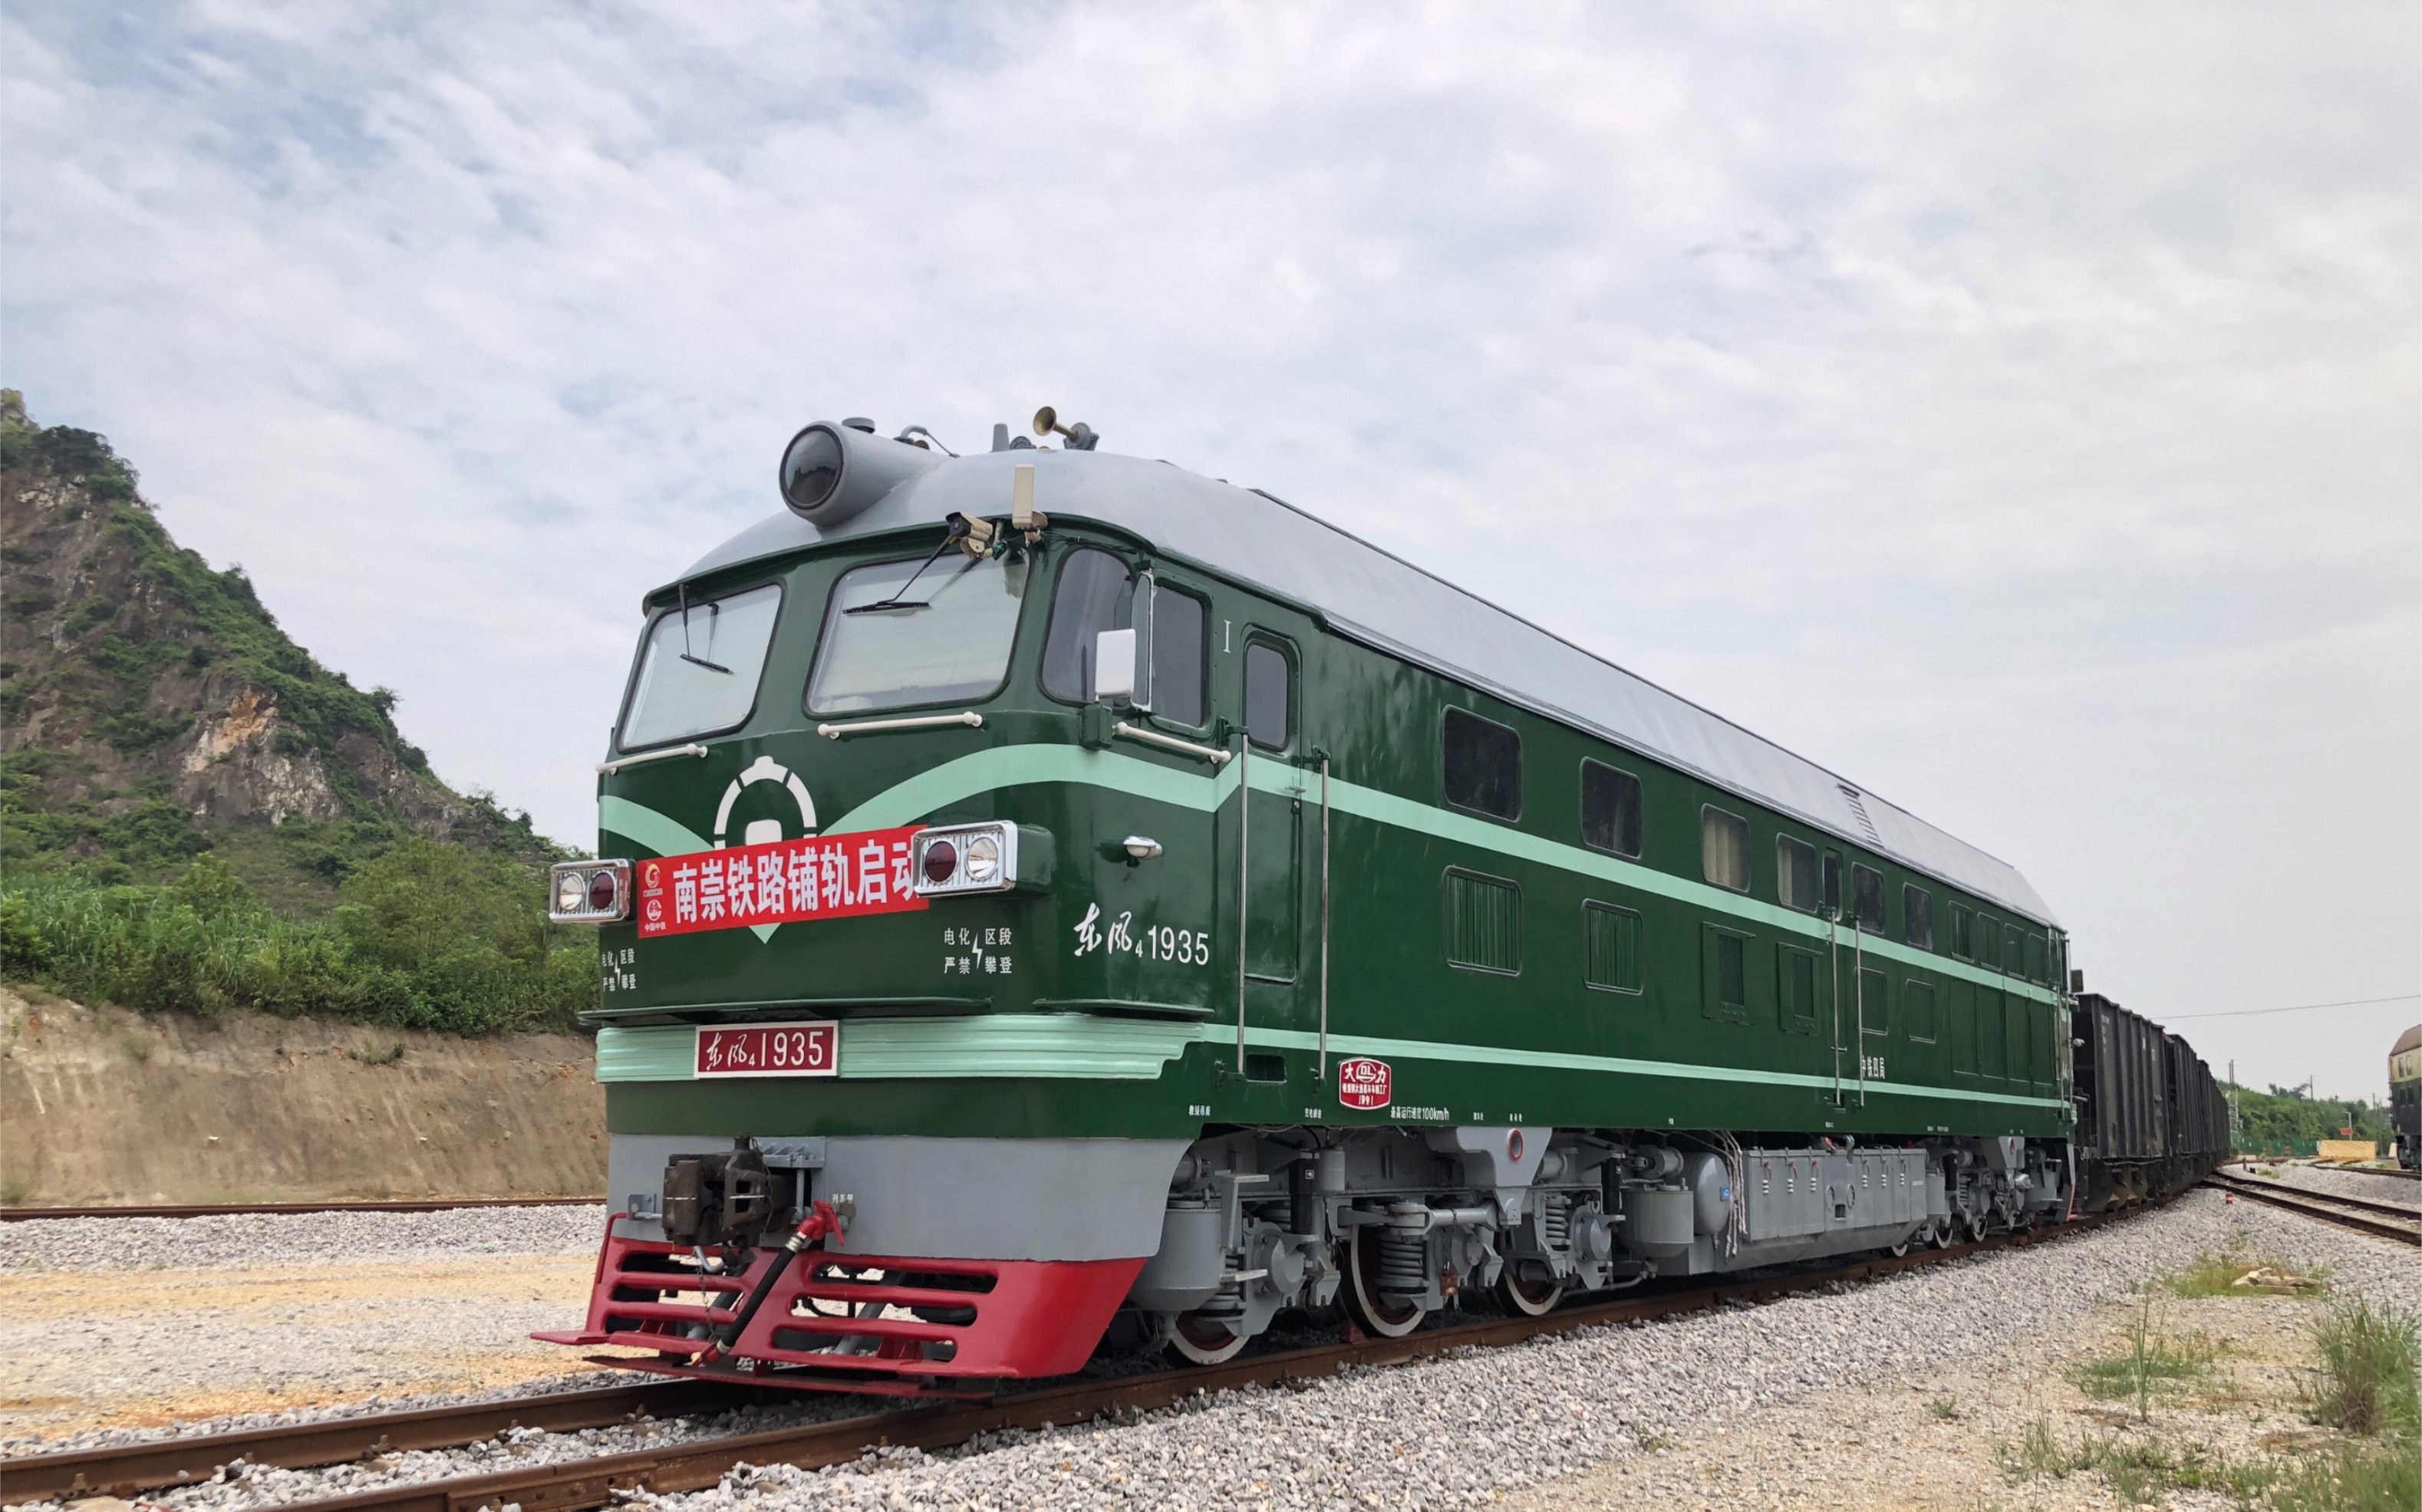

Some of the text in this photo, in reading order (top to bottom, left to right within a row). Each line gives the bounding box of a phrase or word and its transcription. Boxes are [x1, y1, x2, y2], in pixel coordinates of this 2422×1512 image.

[673, 835, 920, 924] 南崇铁路铺轨启动
[944, 927, 1012, 946] 电化 区段
[944, 955, 1012, 974] 严禁 攀登
[1358, 1095, 1374, 1105] 1991
